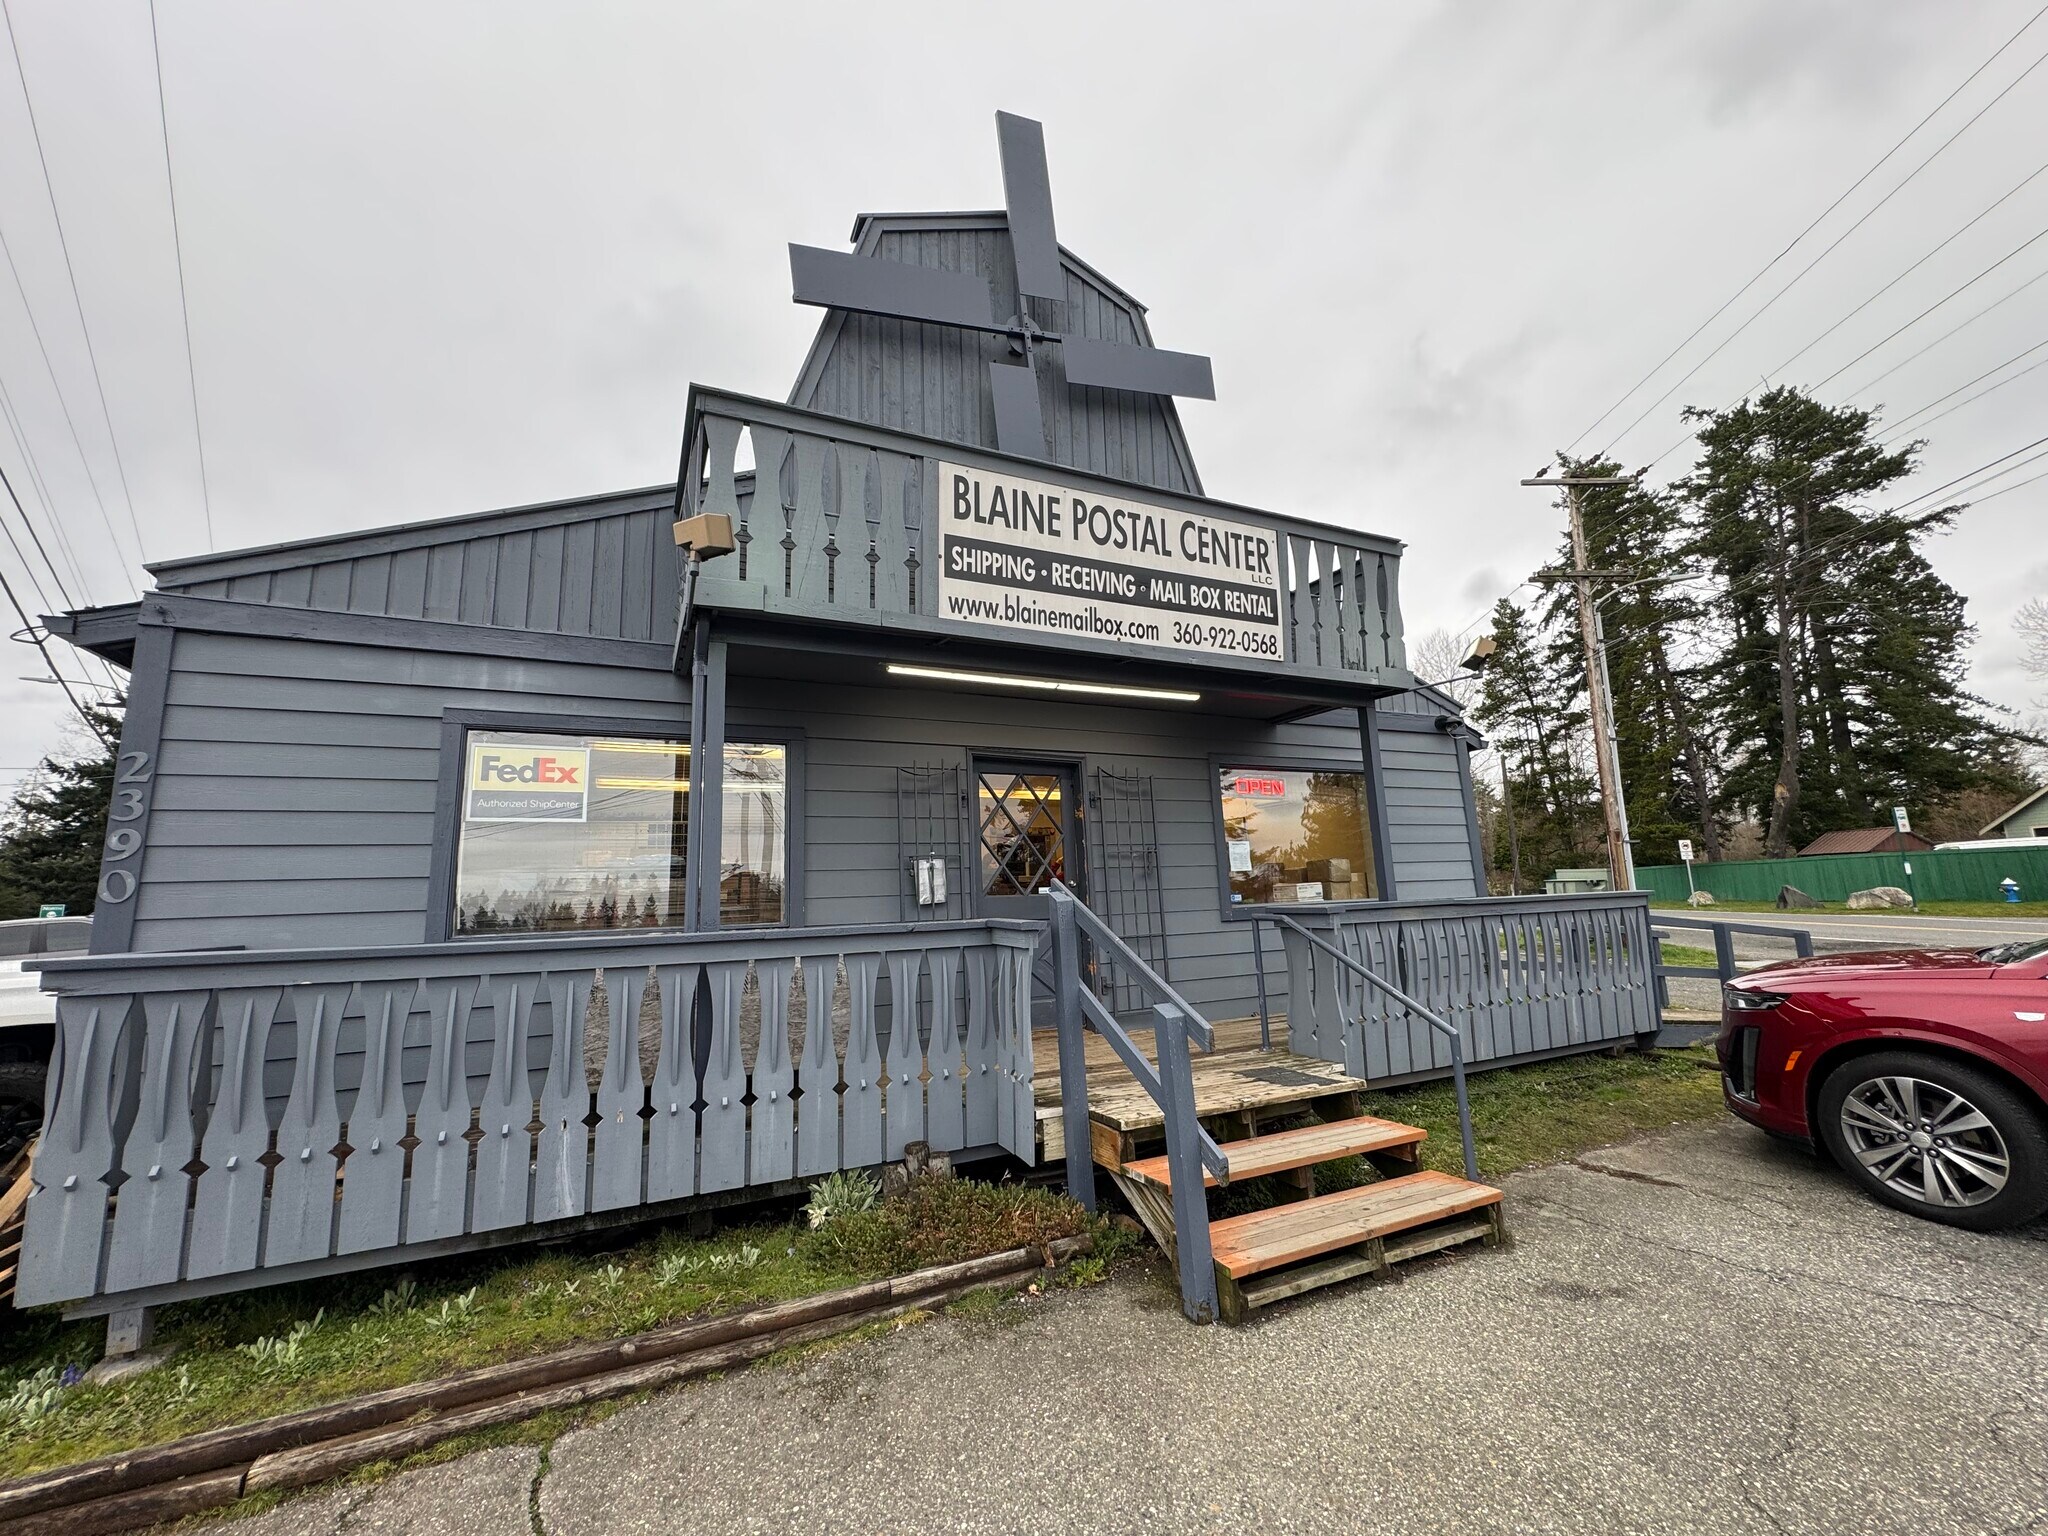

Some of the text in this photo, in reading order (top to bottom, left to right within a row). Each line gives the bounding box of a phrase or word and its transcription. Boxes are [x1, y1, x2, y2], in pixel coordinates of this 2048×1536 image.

[953, 475, 1271, 575] BLAINE POSTAL CENTER
[951, 545, 1274, 618] SHIPPING RECEIVING MAIL BOX RENTAL
[1251, 574, 1273, 585] LLC
[948, 594, 1278, 656] www.blainemailbox.com 360-922-0568
[480, 755, 579, 784] FedEx
[1236, 778, 1284, 796] OPEN
[477, 798, 579, 809] Authorized ShipCenter
[97, 751, 152, 904] 2390
